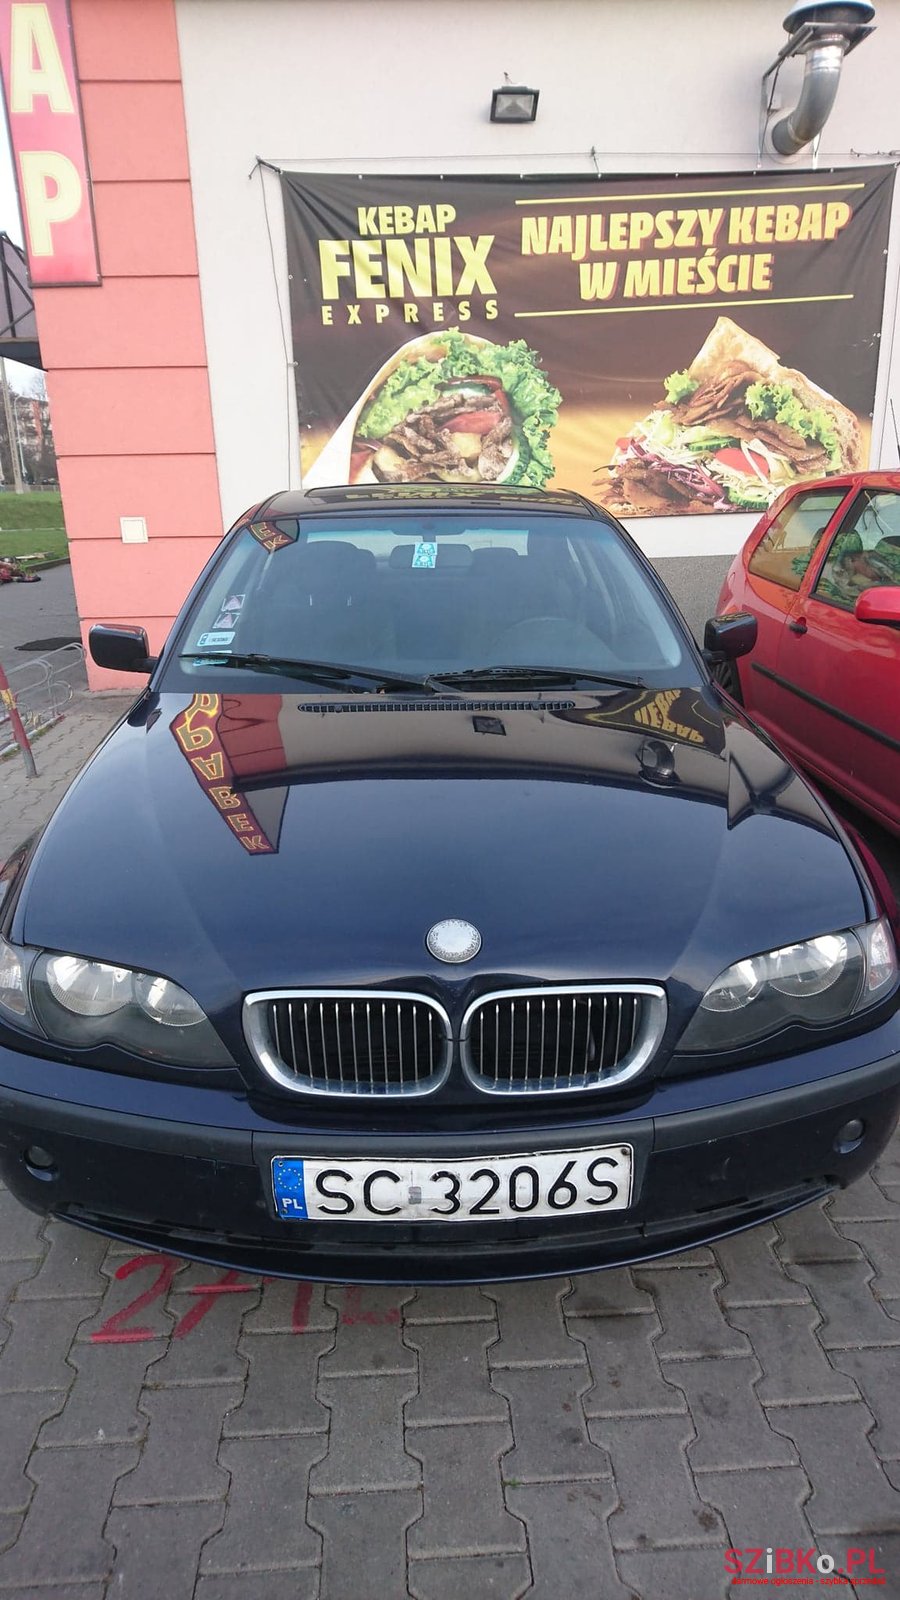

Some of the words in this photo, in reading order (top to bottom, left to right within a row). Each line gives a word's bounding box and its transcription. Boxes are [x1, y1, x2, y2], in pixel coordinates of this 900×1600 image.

[357, 203, 456, 236] KEBAP
[520, 207, 725, 262] NAJLEPSZY
[728, 201, 853, 244] KEBAP
[318, 234, 498, 300] FENIX
[578, 260, 620, 301] W
[623, 247, 774, 298] MIEŚCIE
[321, 299, 498, 325] EXPRESS
[282, 1197, 303, 1210] PL
[315, 1168, 403, 1216] SC
[429, 1156, 620, 1216] 3206S
